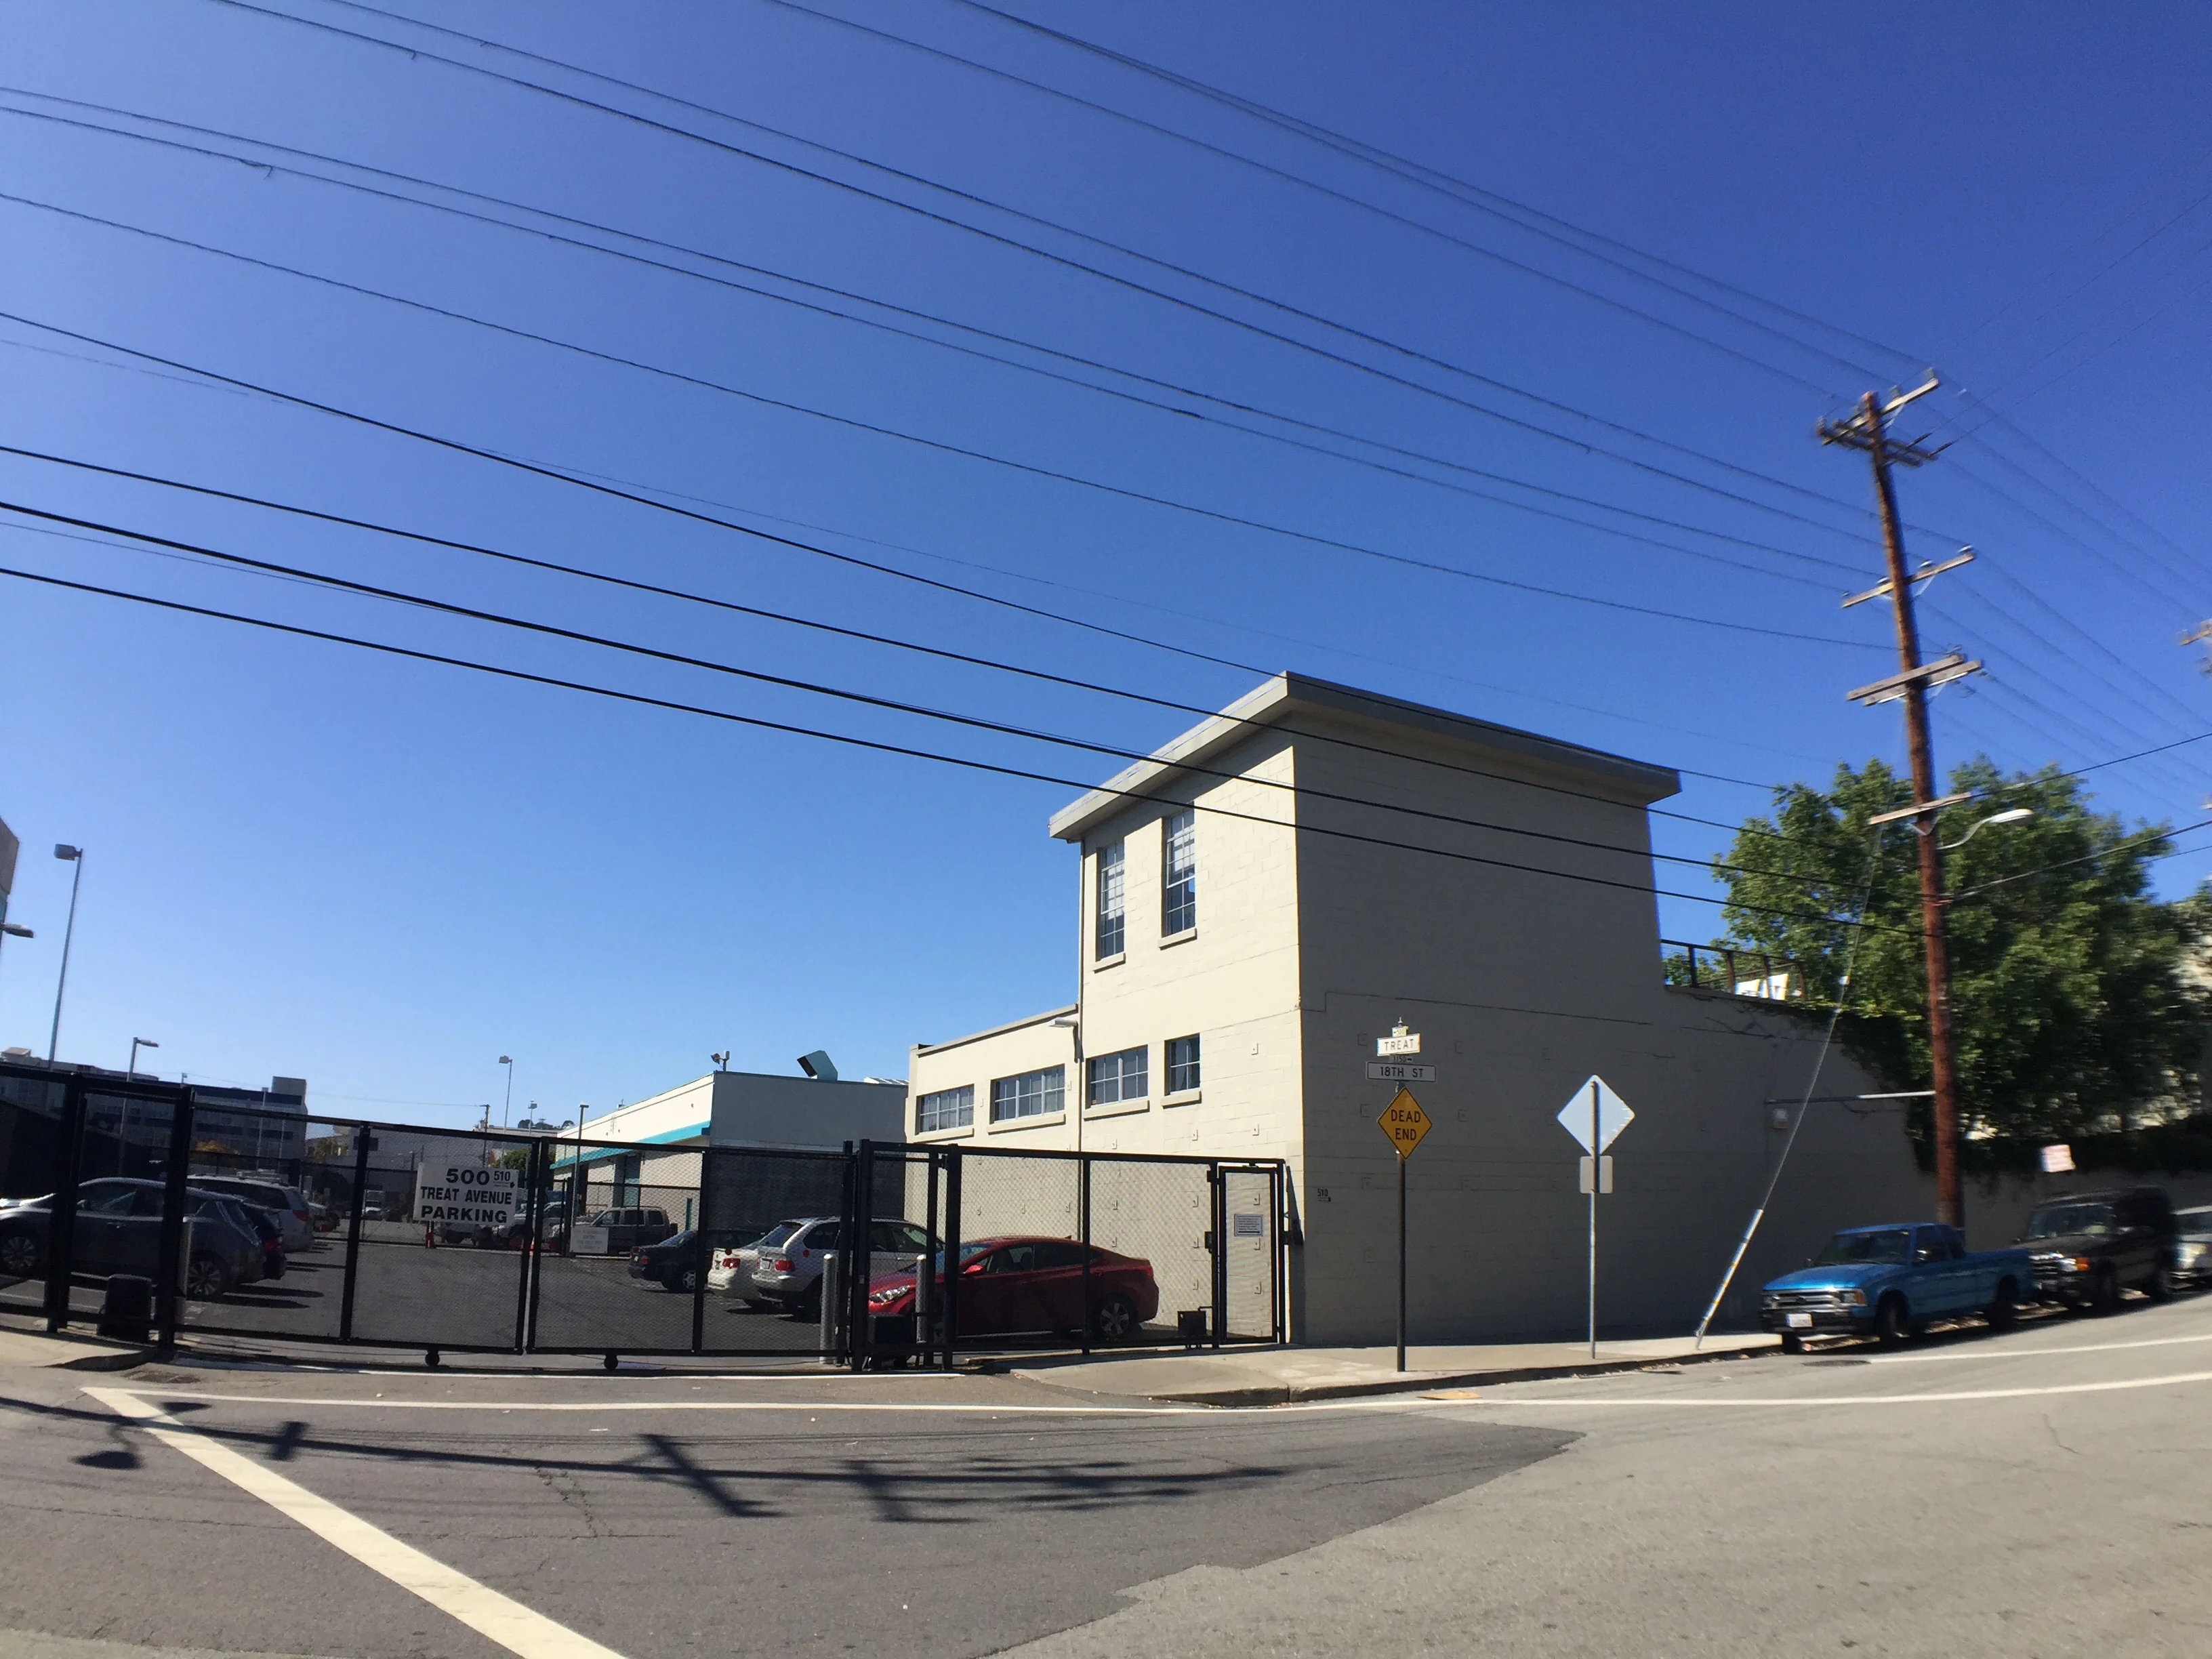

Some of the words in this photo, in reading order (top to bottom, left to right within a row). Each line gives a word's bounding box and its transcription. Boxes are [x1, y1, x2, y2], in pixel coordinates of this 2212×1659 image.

[1384, 1038, 1414, 1051] TREAT
[1380, 1066, 1404, 1078] 18TH
[1412, 1068, 1423, 1078] ST
[1391, 1109, 1421, 1123] DEAD
[1395, 1128, 1416, 1141] END
[446, 1168, 490, 1185] 500
[493, 1170, 511, 1181] 510
[421, 1186, 459, 1202] TREAT
[465, 1189, 512, 1205] AVENUE
[421, 1205, 507, 1223] PARKING
